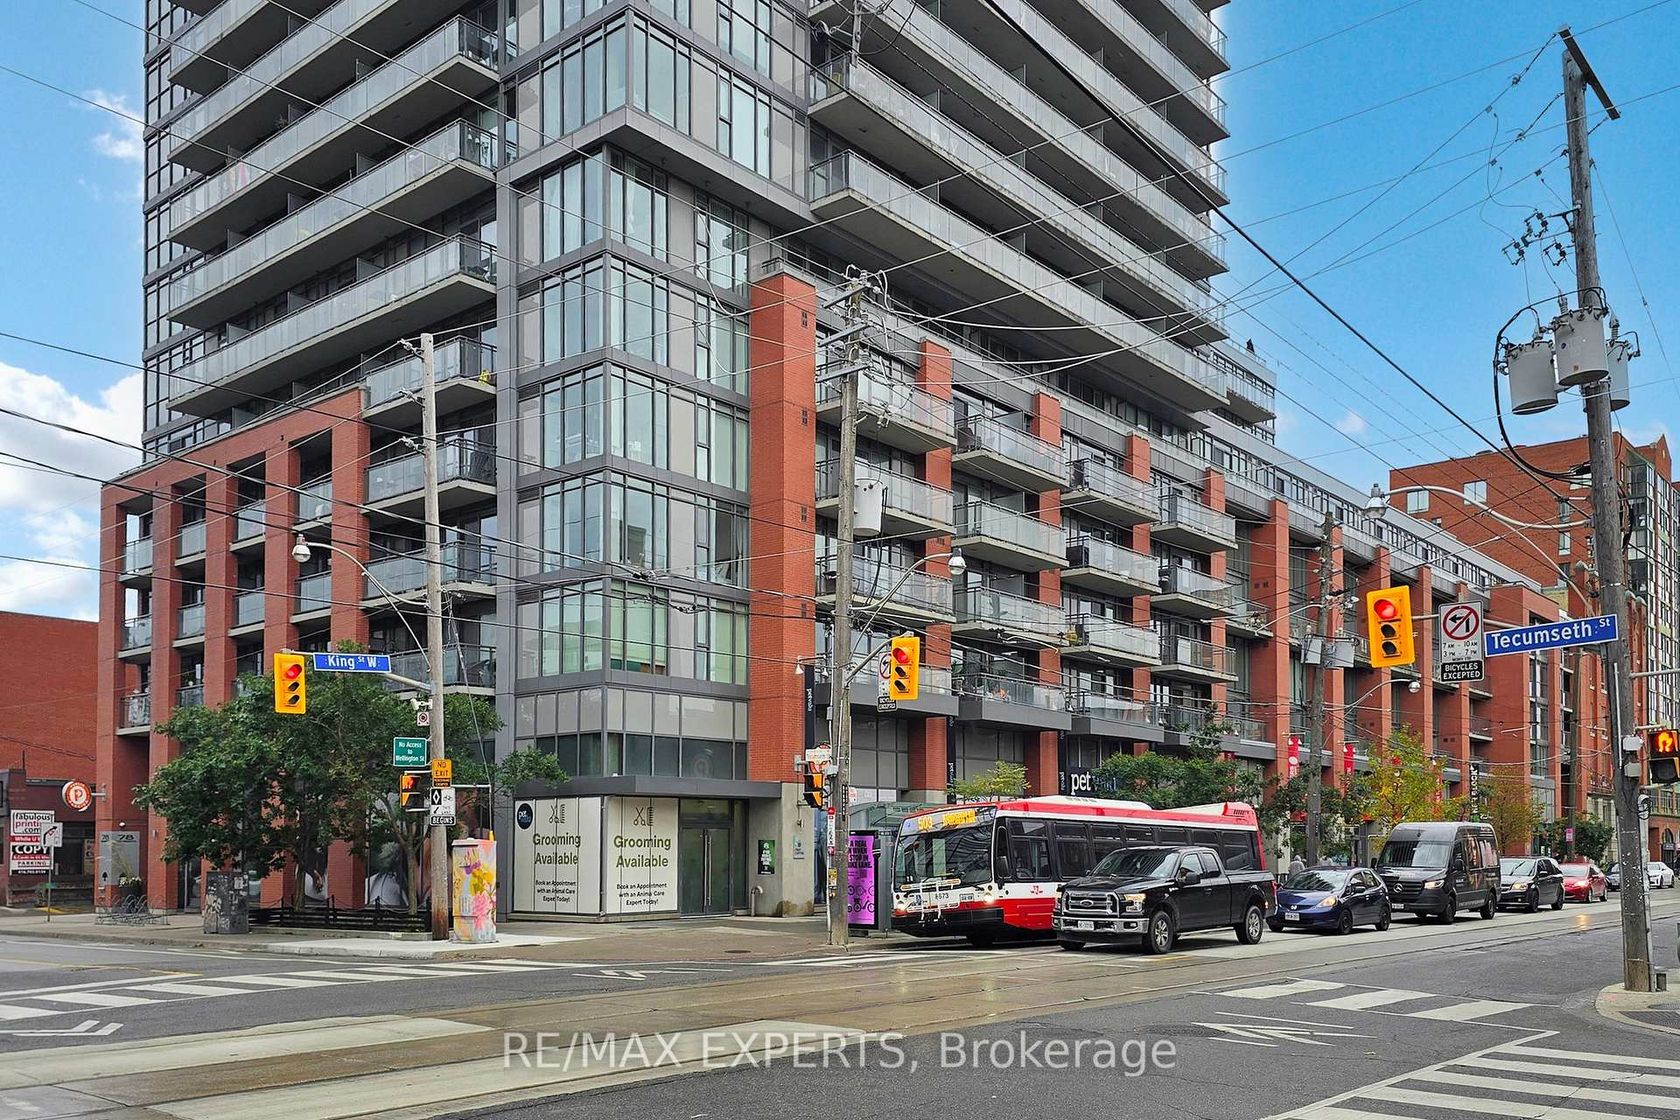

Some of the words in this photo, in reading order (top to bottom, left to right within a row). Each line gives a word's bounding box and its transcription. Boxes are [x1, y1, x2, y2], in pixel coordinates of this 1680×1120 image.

[1491, 624, 1592, 649] Tecumseth
[1599, 617, 1611, 628] St
[327, 655, 355, 670] King
[366, 656, 376, 668] W
[1445, 662, 1478, 672] BICYCLES
[1443, 670, 1480, 680] EXCEPTED
[16, 812, 50, 820] fabulous
[532, 832, 581, 848] Grooming
[614, 835, 672, 850] Grooming
[16, 845, 48, 854] COPY
[534, 852, 578, 865] Available
[616, 855, 668, 868] Available
